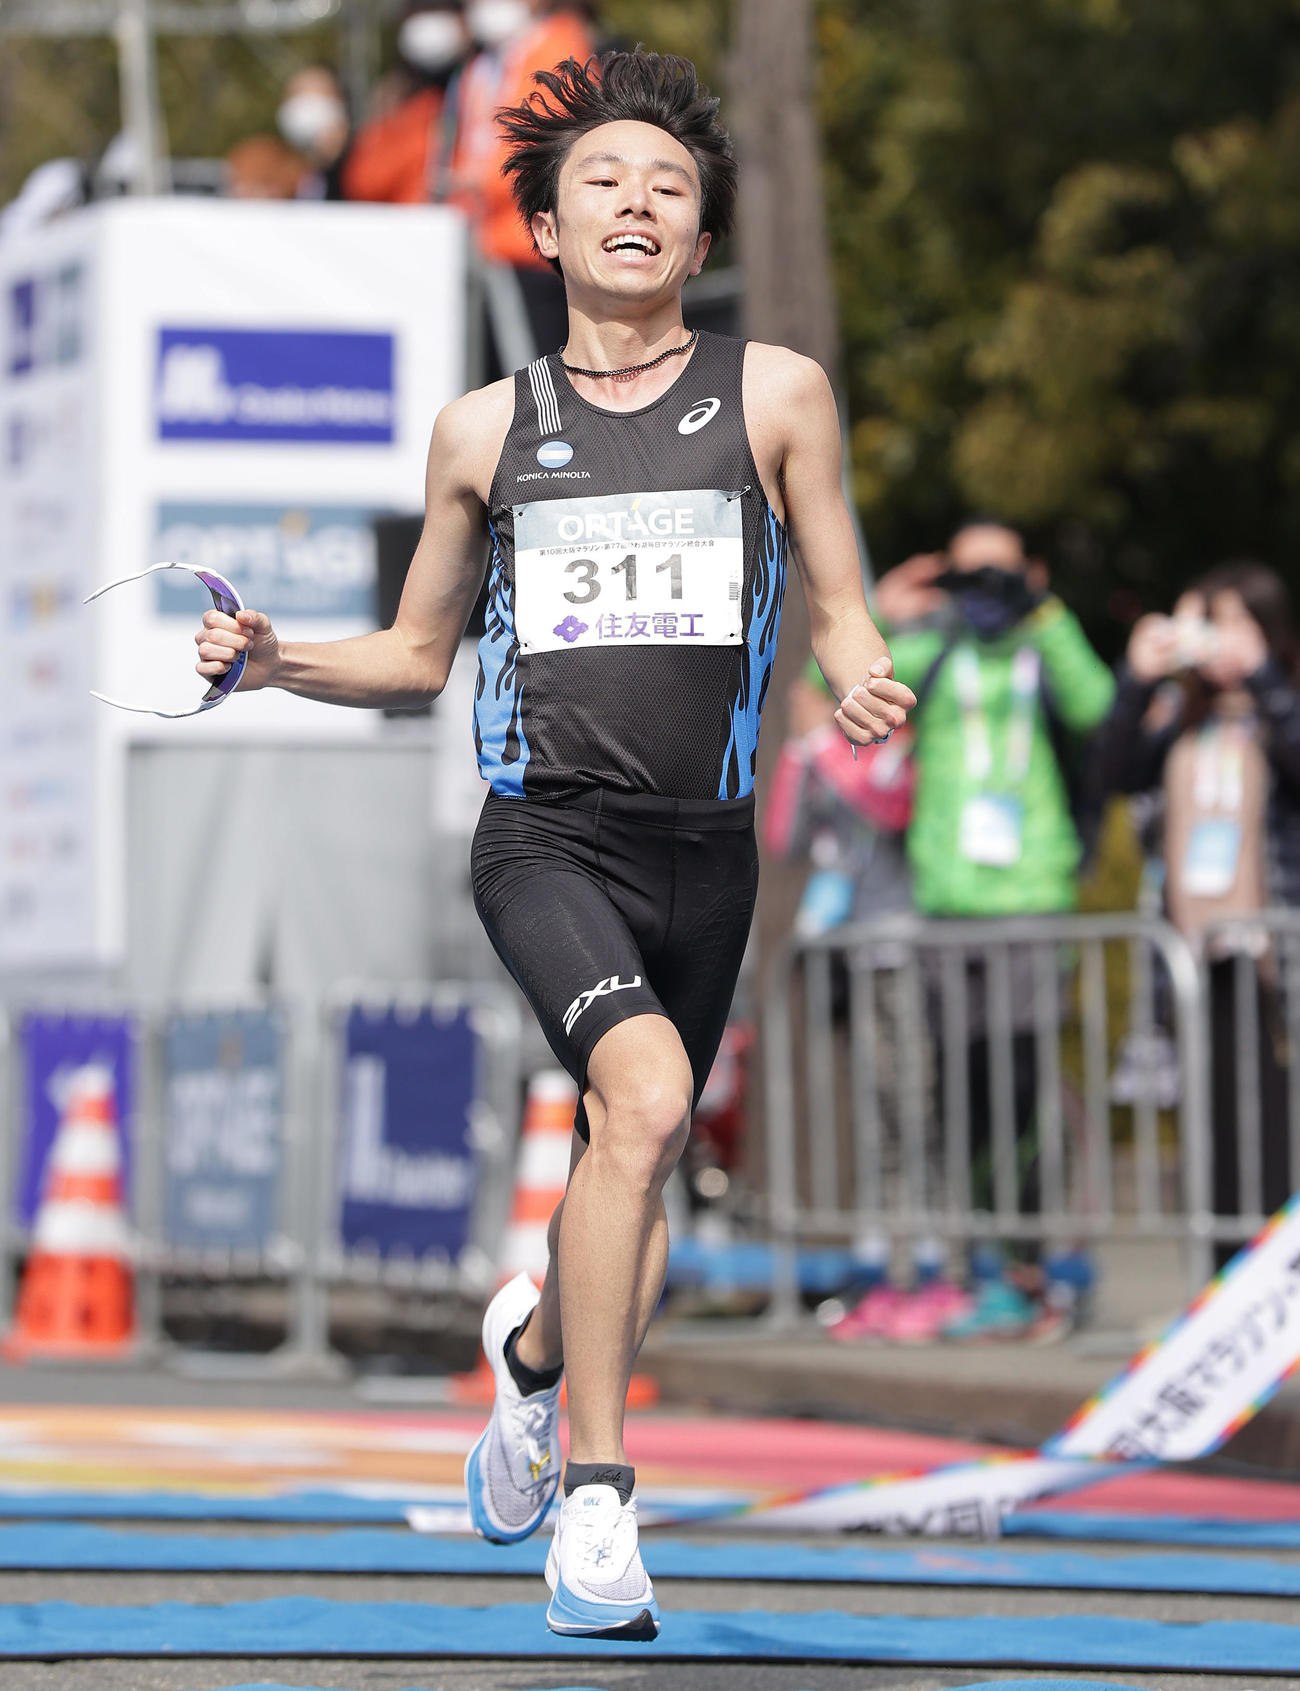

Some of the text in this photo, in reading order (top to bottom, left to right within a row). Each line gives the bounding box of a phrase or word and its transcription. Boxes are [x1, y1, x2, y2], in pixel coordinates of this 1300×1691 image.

[517, 471, 591, 482] KONICA MINOLTA
[563, 553, 683, 605] 311
[596, 611, 705, 640] 住友電工
[562, 975, 642, 1037] 2XU
